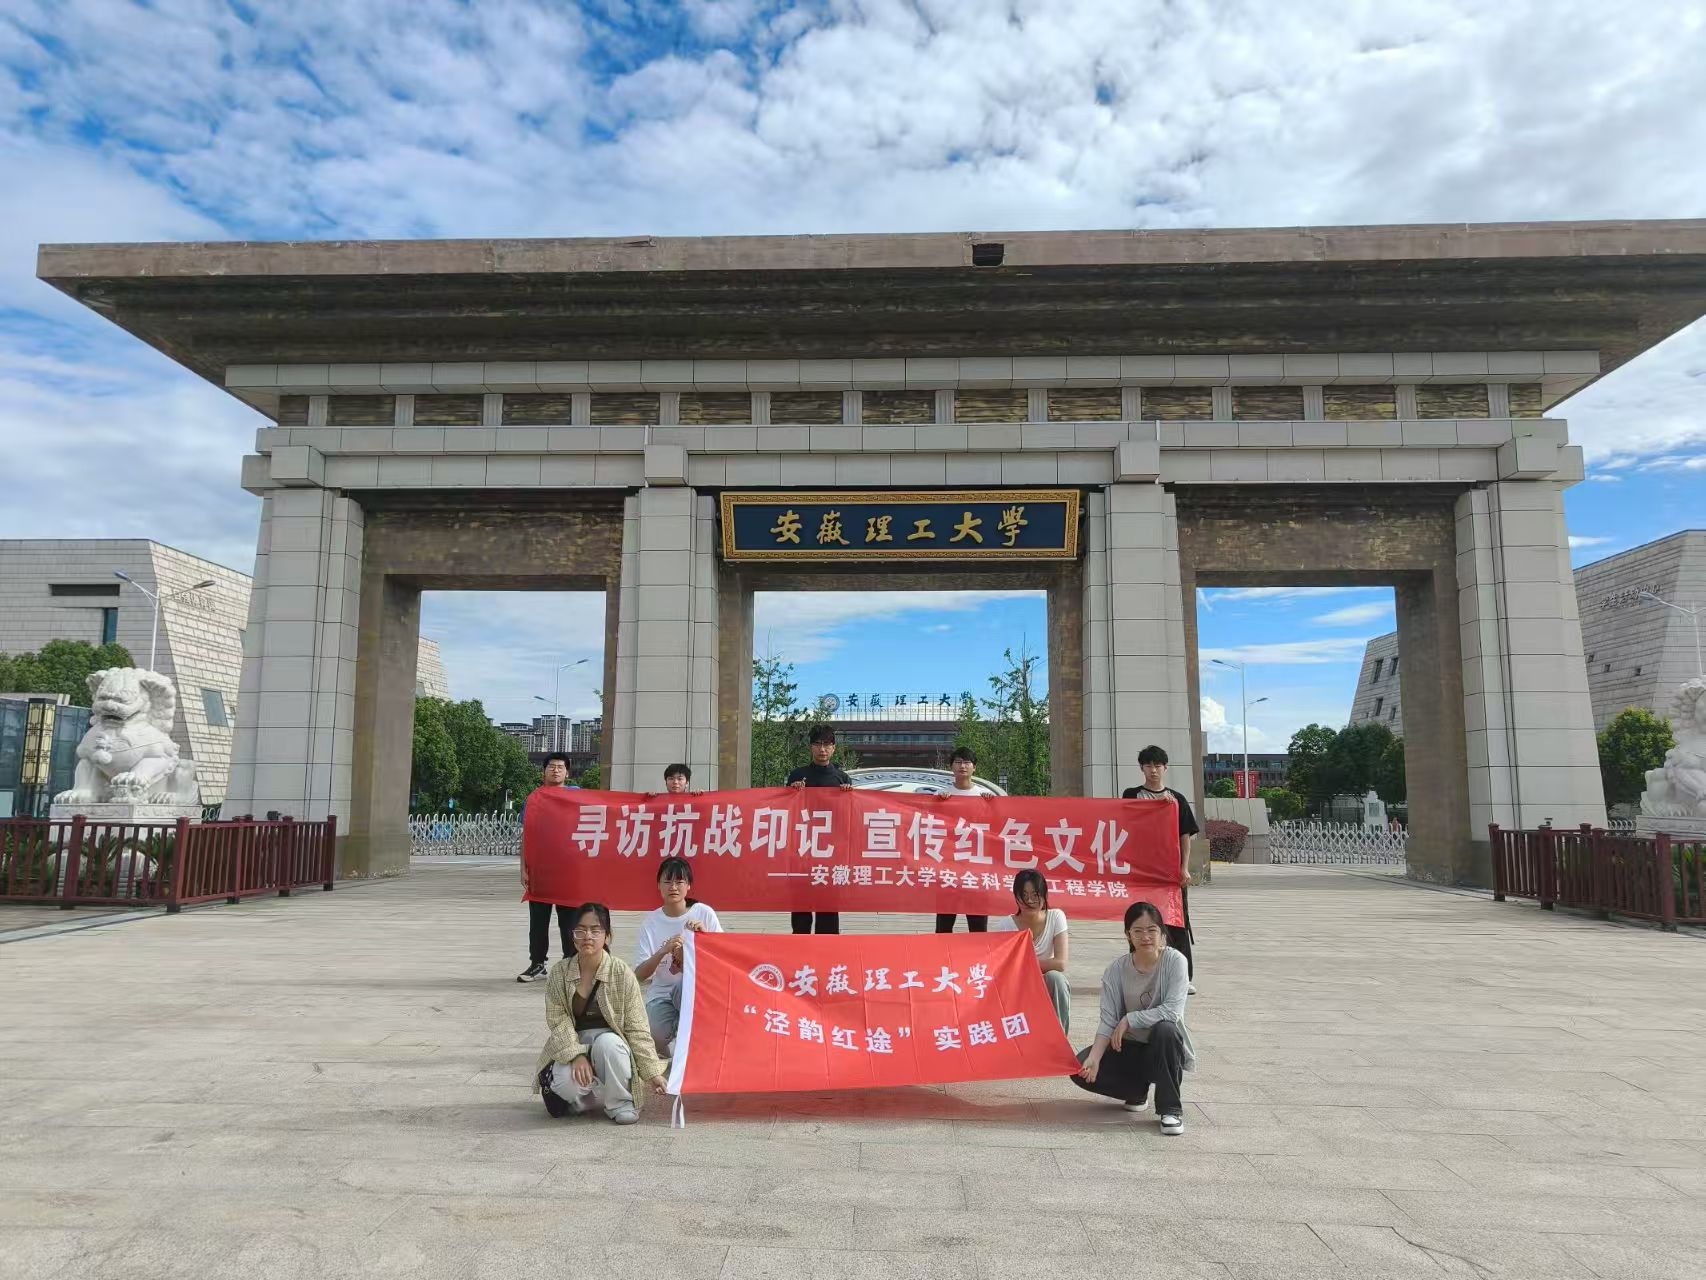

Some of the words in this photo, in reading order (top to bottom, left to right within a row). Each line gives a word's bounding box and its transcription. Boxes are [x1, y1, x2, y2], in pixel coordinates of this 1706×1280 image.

[571, 803, 834, 858] 寻访抗战印记
[861, 808, 1131, 874] 宣传红色文化
[933, 1012, 1029, 1051] 实践团
